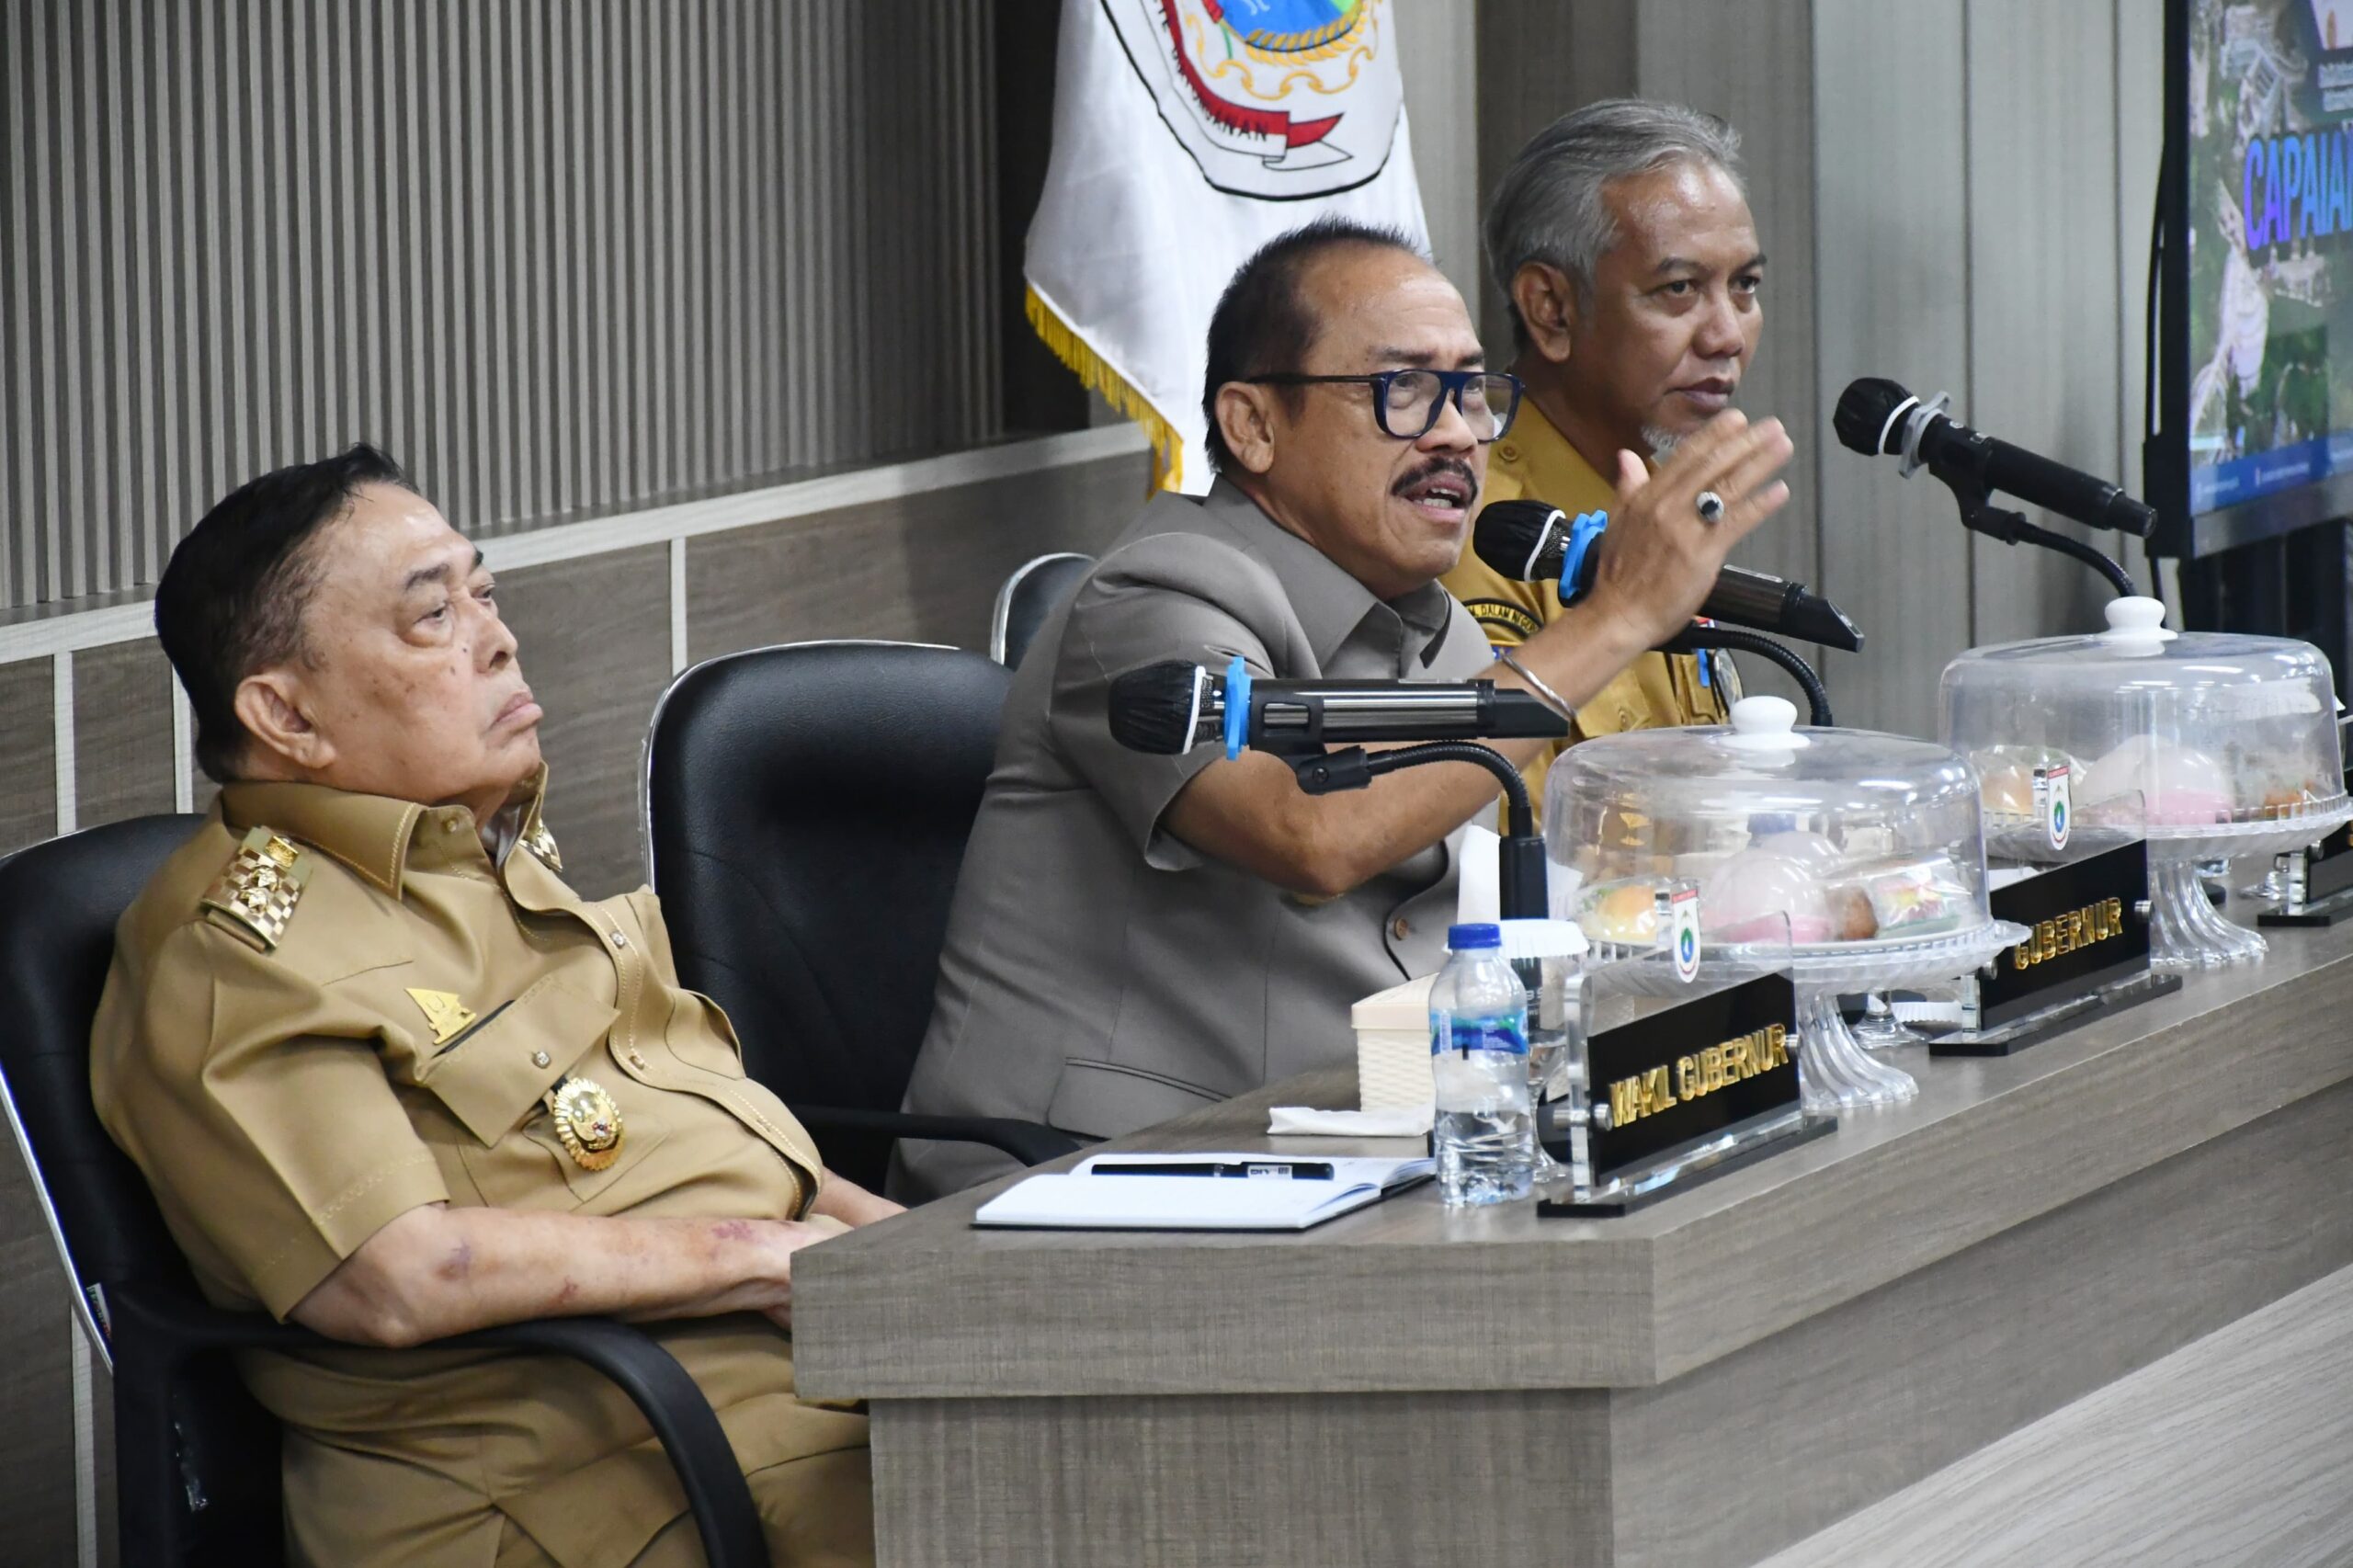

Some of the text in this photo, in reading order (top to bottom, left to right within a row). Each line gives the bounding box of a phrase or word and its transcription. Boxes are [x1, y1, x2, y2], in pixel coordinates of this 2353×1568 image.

[1481, 604, 1510, 619] DALAM
[1609, 1023, 1789, 1128] WAKIL GUBERNUR
